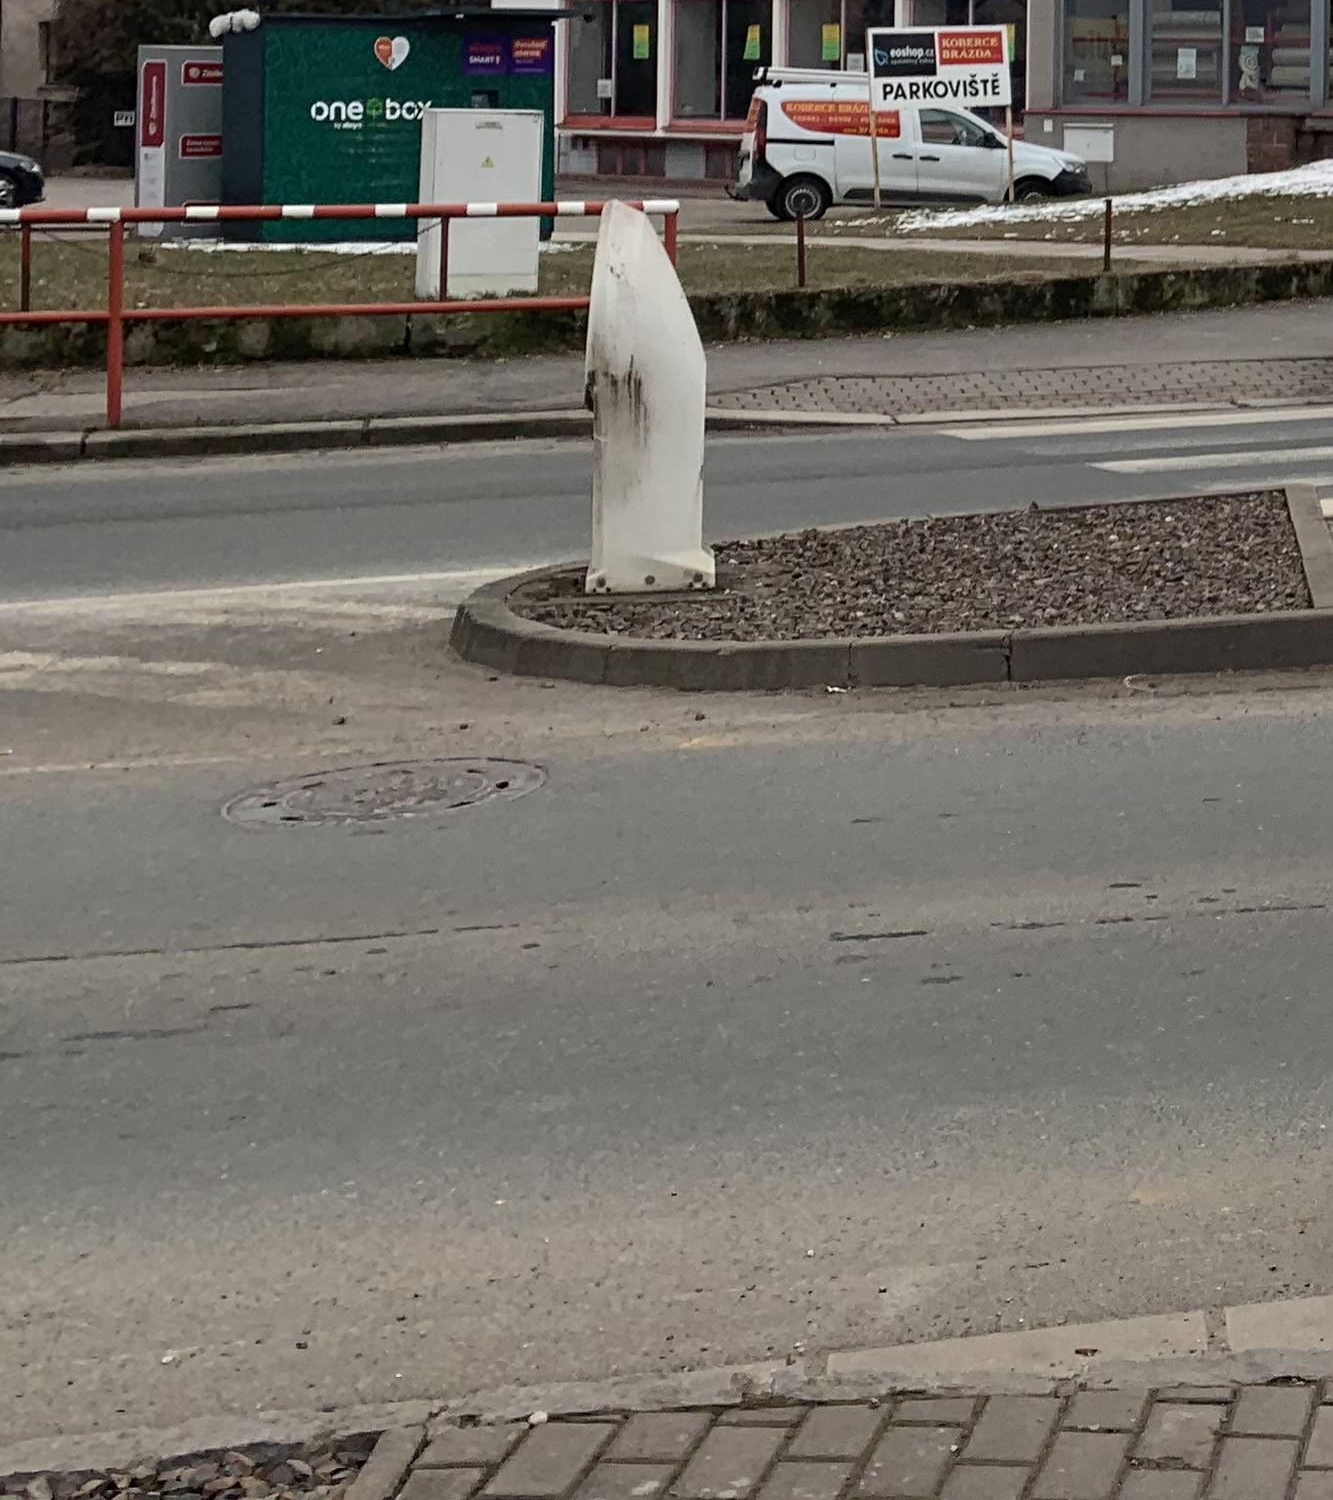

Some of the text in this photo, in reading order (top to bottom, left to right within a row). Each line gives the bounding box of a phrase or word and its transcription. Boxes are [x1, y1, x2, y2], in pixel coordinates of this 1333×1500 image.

[942, 37, 998, 48] KOBERCE
[942, 47, 991, 59] BRÁZDA
[882, 72, 1000, 101] PARKOVIŠTĚ
[310, 97, 432, 121] one box
